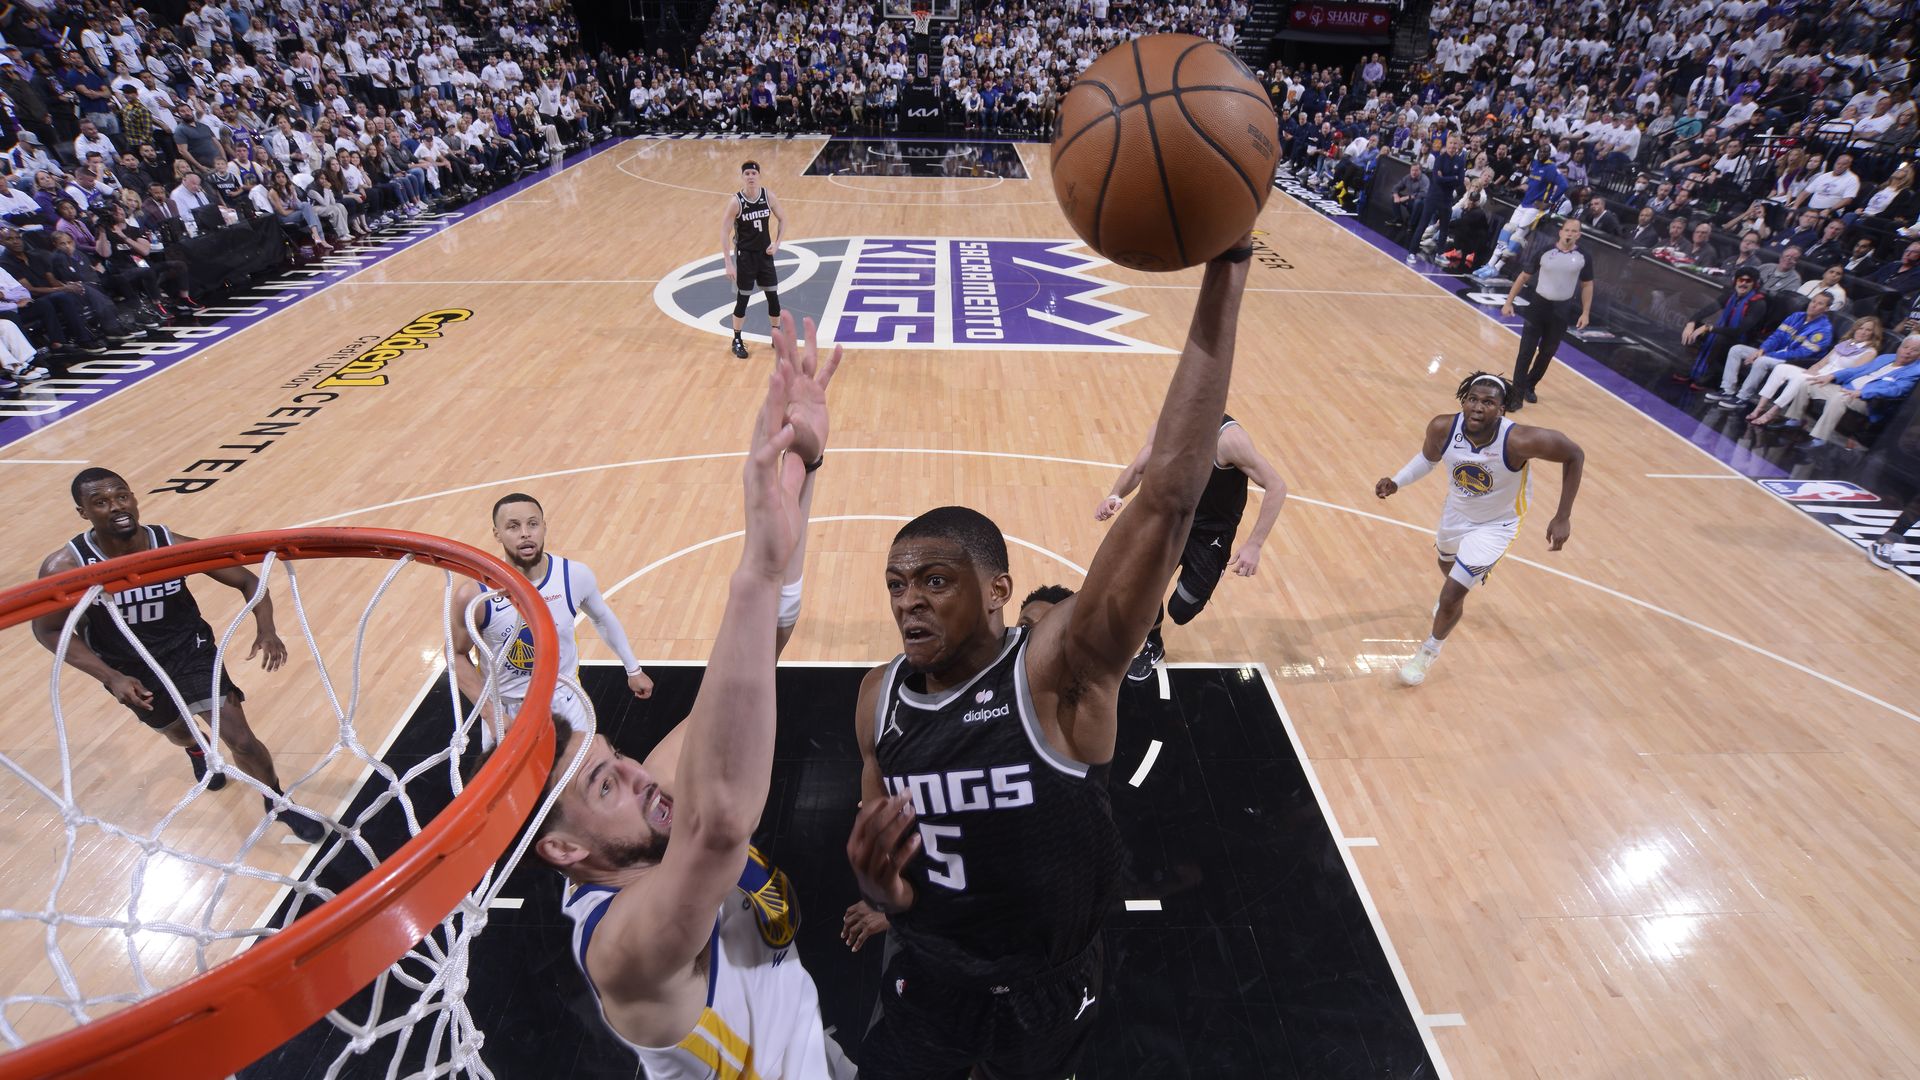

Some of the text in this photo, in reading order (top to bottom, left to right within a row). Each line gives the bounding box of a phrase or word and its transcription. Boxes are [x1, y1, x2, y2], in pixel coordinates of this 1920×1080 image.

[1327, 10, 1368, 23] SHARIF
[742, 209, 770, 221] KINGS
[753, 220, 762, 232] 9
[193, 212, 464, 316] SACRAMENTO
[833, 239, 937, 343] KINGS
[960, 242, 1004, 340] SACRAMENTO
[0, 327, 231, 416] PROUD
[281, 335, 381, 389] Credit Union
[147, 392, 339, 494] CENTER
[1478, 472, 1486, 481] 5
[964, 704, 1010, 722] dialpad
[884, 764, 1034, 815] INGS
[919, 822, 966, 891] 5
